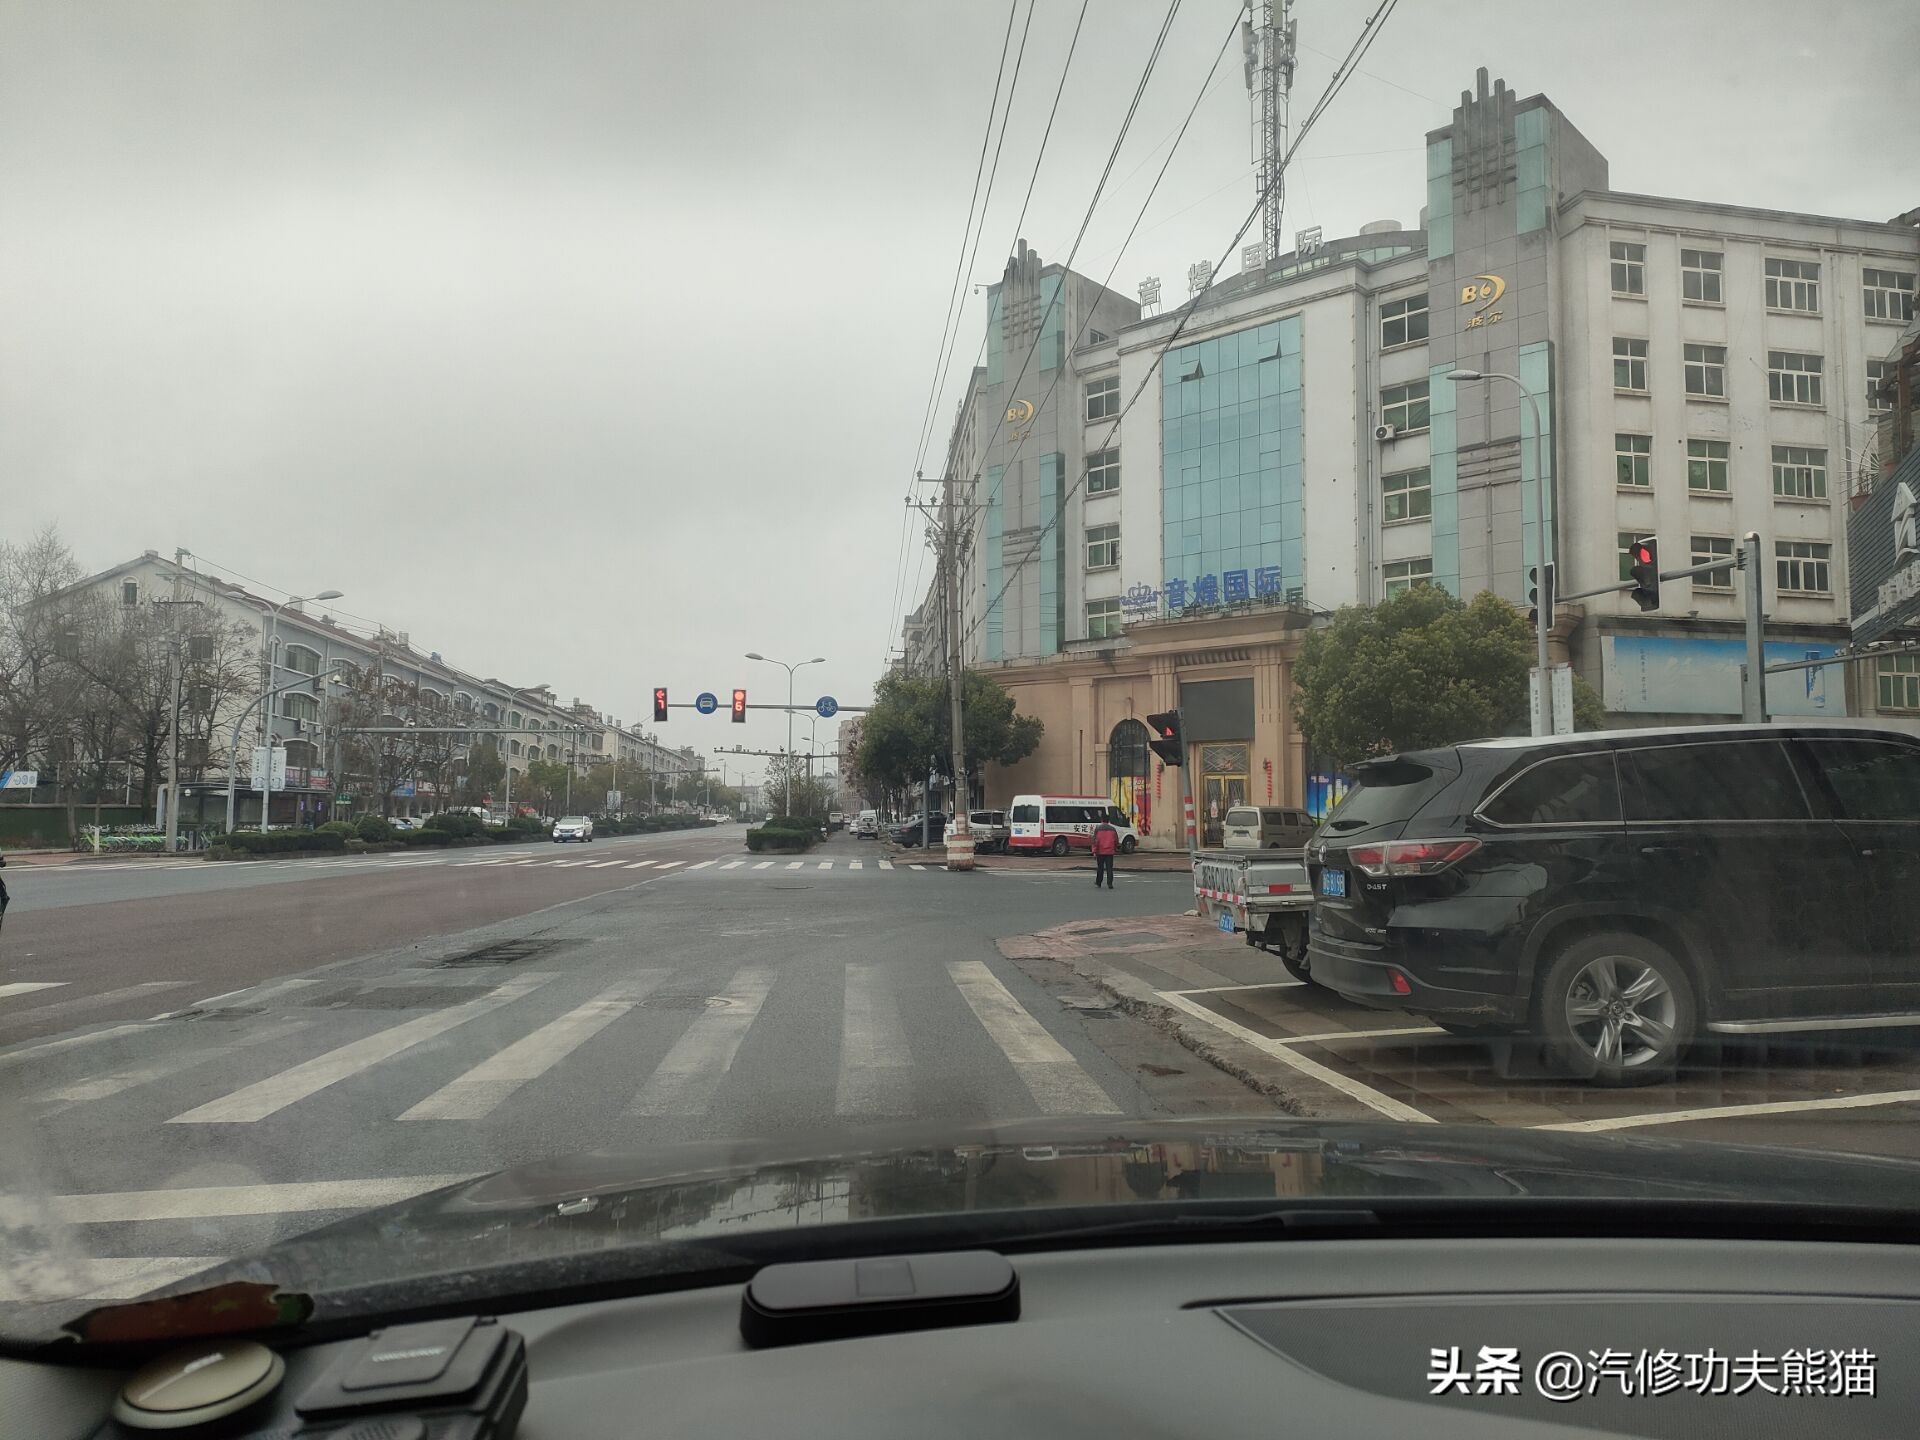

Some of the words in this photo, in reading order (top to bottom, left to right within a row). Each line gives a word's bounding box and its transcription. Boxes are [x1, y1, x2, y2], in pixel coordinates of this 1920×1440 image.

[1138, 225, 1325, 306] 音煌国际
[1165, 566, 1282, 608] 音煌国际
[735, 701, 743, 711] 6
